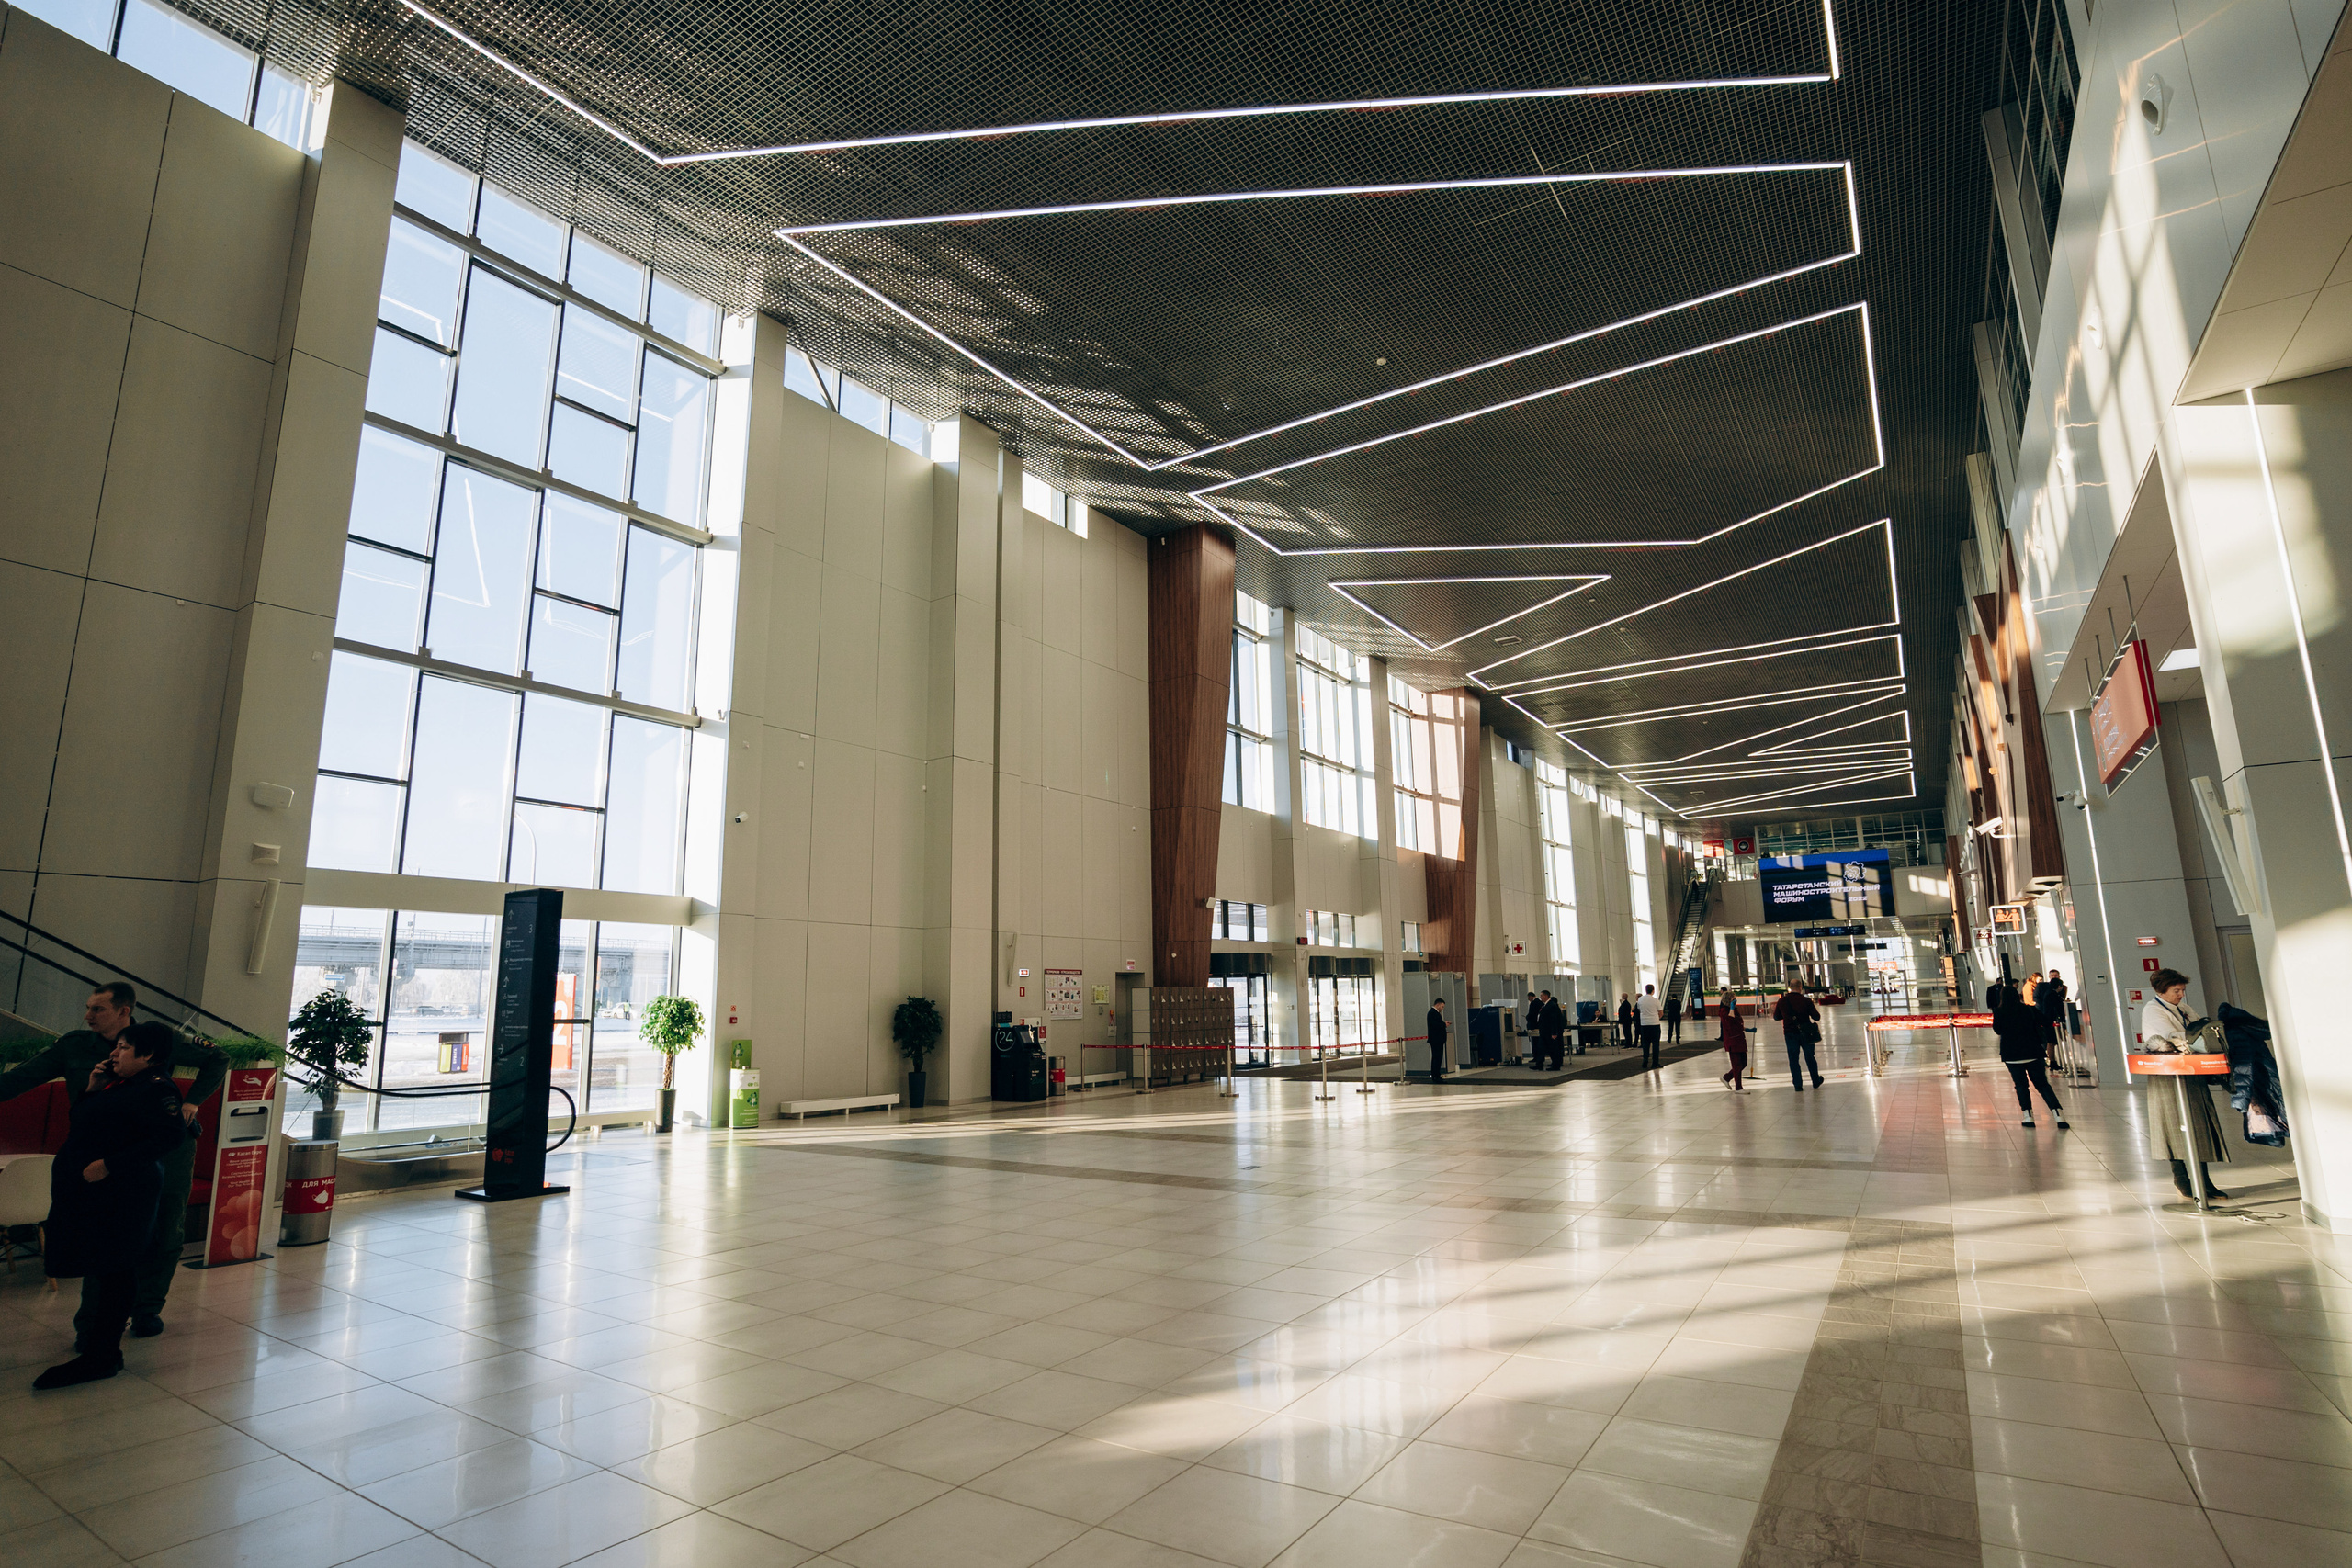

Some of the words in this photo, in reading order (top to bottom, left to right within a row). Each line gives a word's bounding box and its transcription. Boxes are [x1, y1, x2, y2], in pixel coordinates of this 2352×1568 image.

[1772, 880, 1842, 890] ТАТАРСТАНСКИЙ
[1773, 884, 1880, 897] МАШИНОСТРОИТЕЛЬНЫЙ
[528, 923, 533, 934] 3
[999, 1031, 1013, 1044] 24
[519, 1056, 525, 1066] 2
[301, 1180, 319, 1189] ДЛЯ
